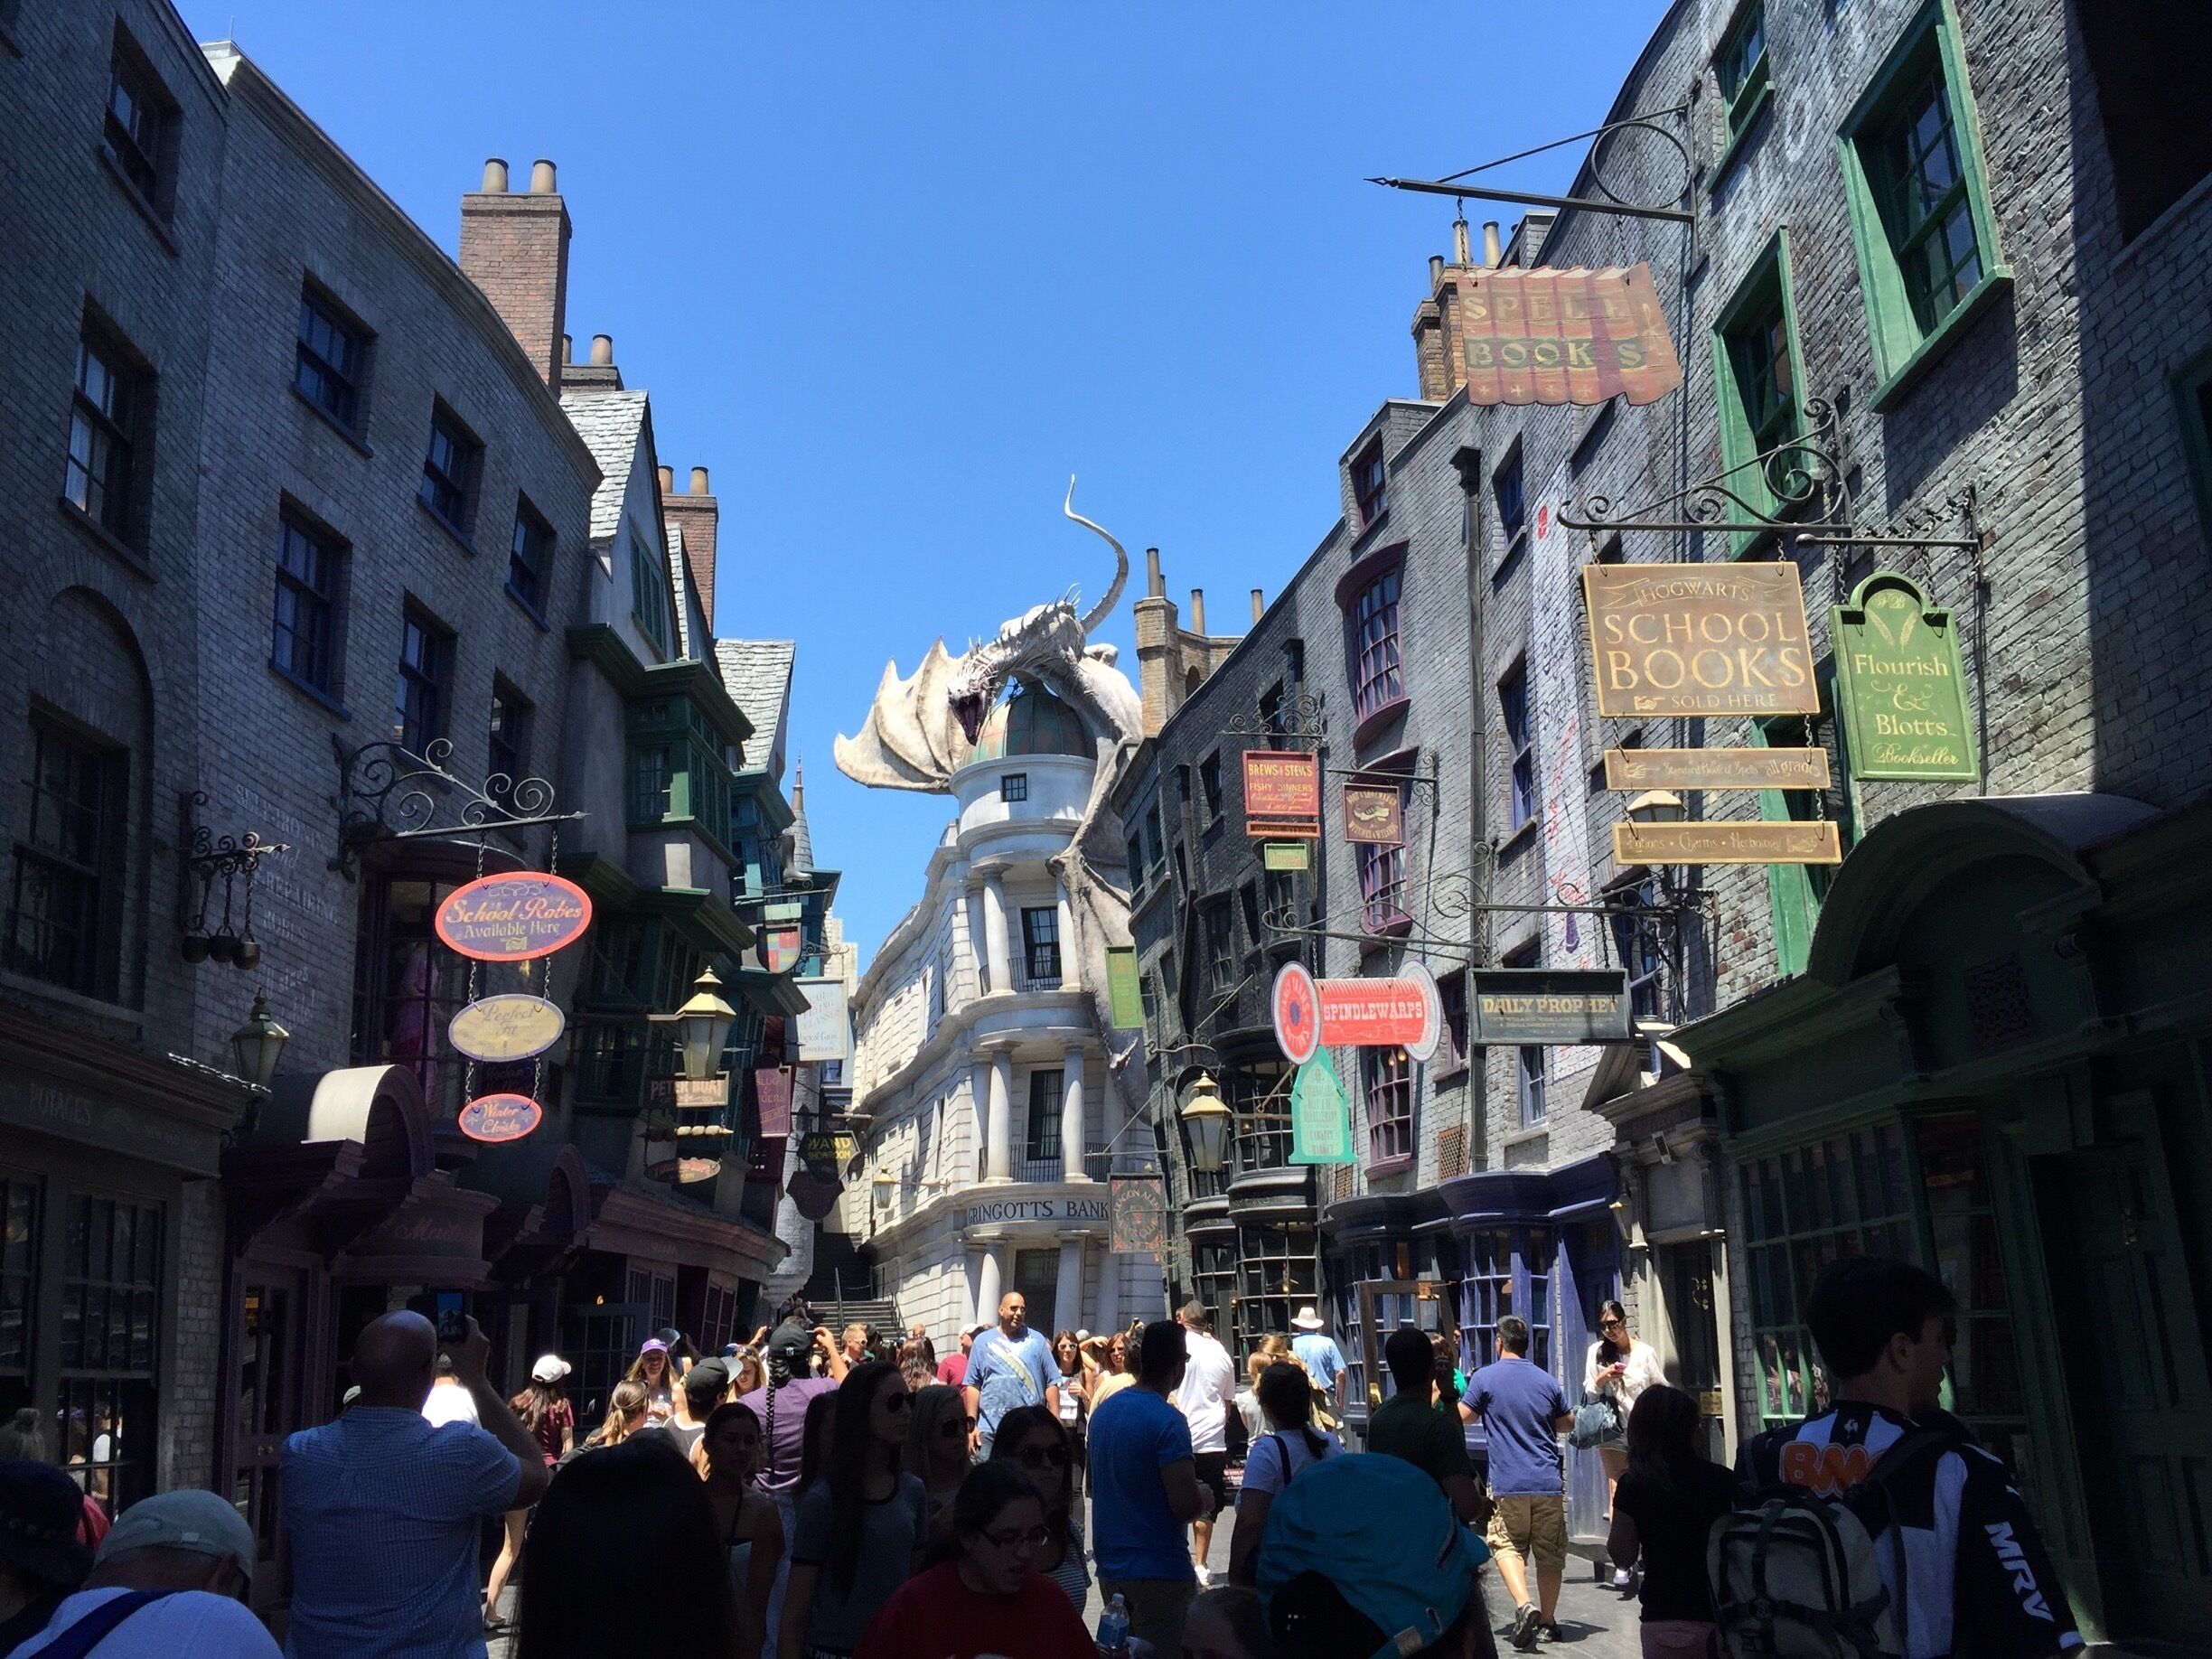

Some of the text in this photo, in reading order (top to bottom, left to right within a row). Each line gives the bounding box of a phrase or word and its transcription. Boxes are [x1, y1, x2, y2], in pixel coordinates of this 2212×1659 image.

[1467, 342, 1642, 365] BOOKS
[1641, 581, 1751, 601] HOGWARTS
[1604, 612, 1797, 643] SCHOOL
[1606, 647, 1805, 689] BOOKS
[1853, 653, 1949, 677] Flourish
[1671, 692, 1779, 709] SOLD HERE
[1871, 680, 1935, 711] &
[1875, 713, 1948, 737] Blotts
[1871, 742, 1959, 765] Bookseller
[1248, 764, 1278, 776] BREWS
[1284, 764, 1313, 777] STEWS
[1766, 759, 1780, 777] all
[1249, 783, 1314, 792] FISHY DINNERS
[1678, 831, 1718, 851] Charms
[444, 897, 583, 924] School Robes
[464, 921, 560, 940] Available Here
[480, 1003, 537, 1024] Perfect
[1323, 1001, 1423, 1022] SPINDLEWARPS
[1483, 997, 1618, 1013] DAILY PROPHET
[481, 1102, 520, 1119] Winter
[480, 1119, 521, 1135] Cloaks
[809, 1137, 851, 1149] WAND
[968, 1200, 1109, 1224] GRINGOTTS BANK
[1779, 1440, 1888, 1500] BM
[1983, 1521, 2056, 1623] MRV
